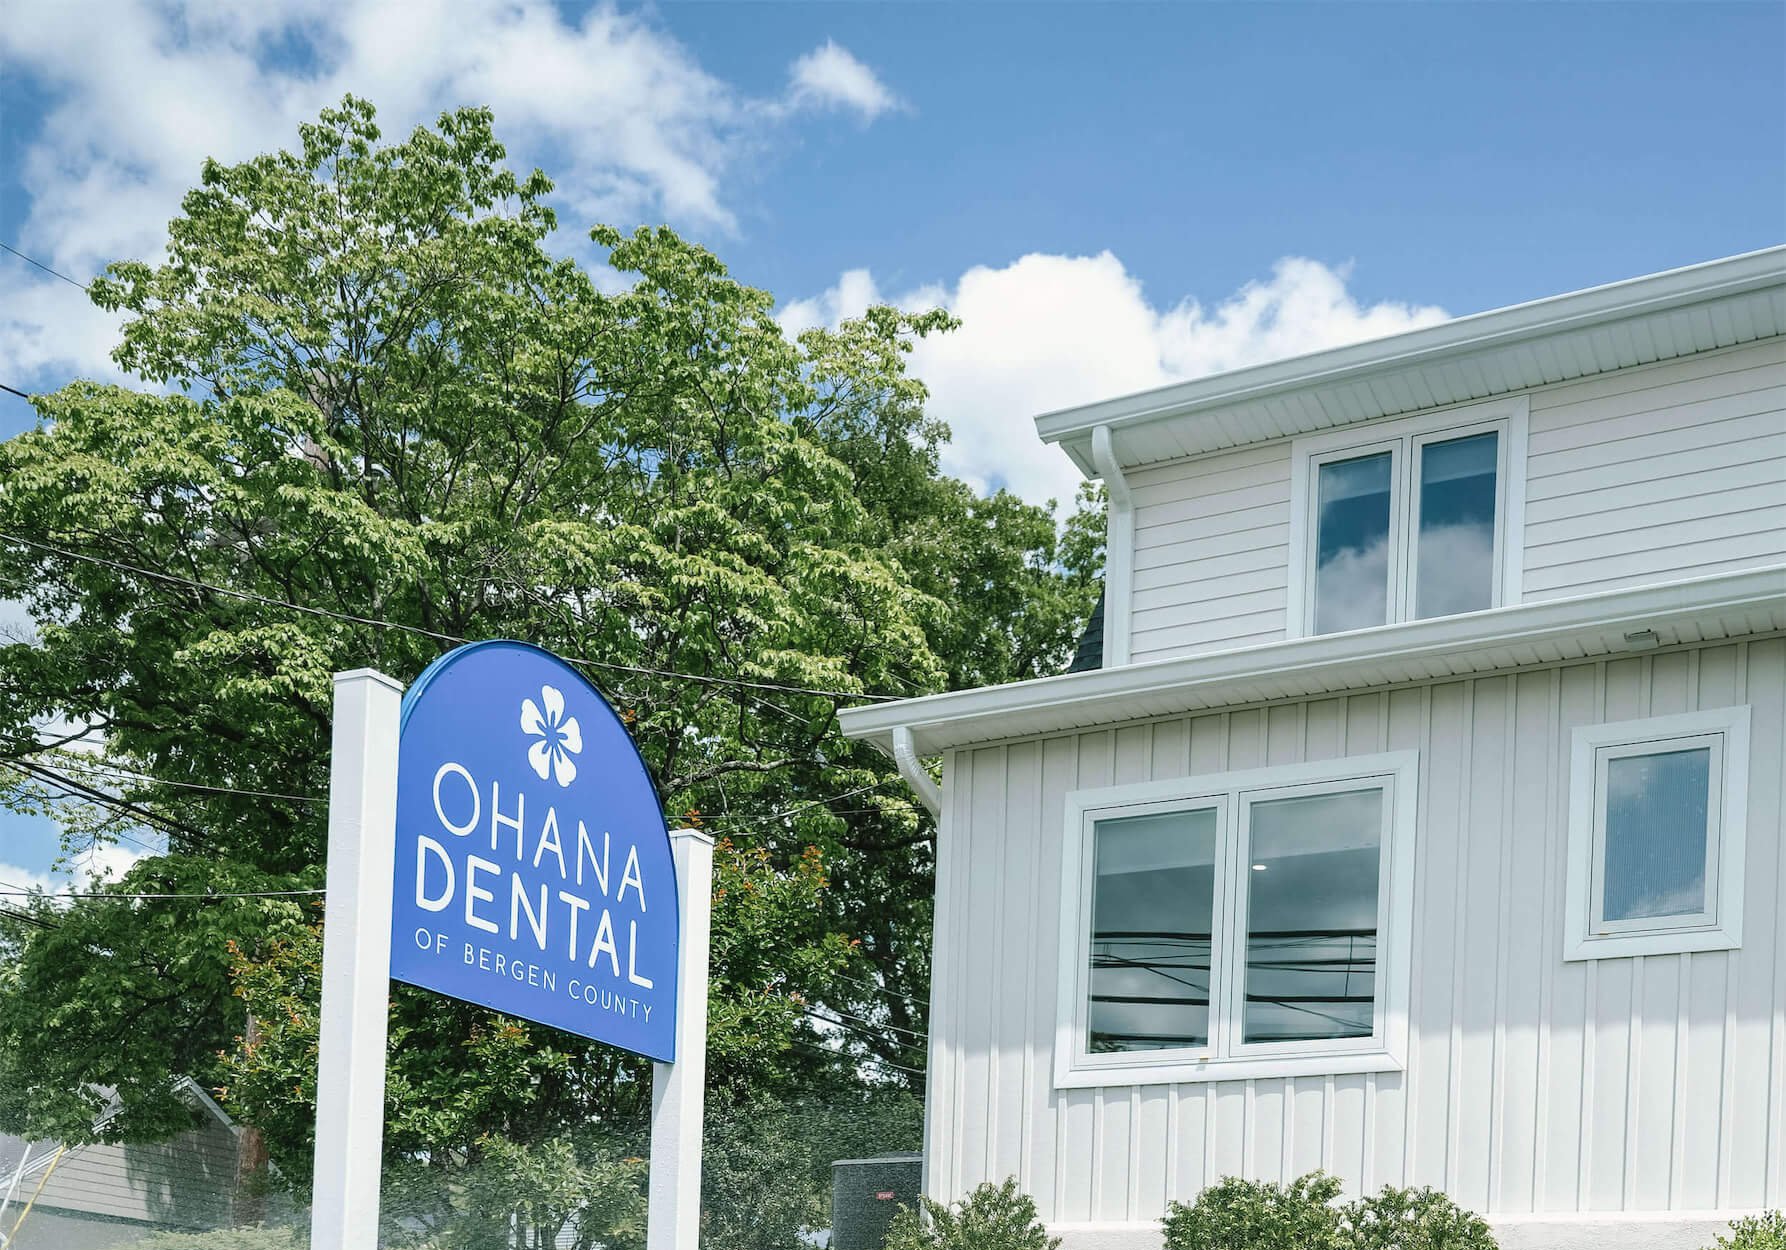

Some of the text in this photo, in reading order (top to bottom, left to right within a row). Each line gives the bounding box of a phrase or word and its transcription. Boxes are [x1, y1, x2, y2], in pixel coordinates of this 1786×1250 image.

[415, 834, 654, 990] DENTAL
[432, 762, 647, 913] OHANA
[415, 927, 652, 1024] OF BERGEN COUNTY
